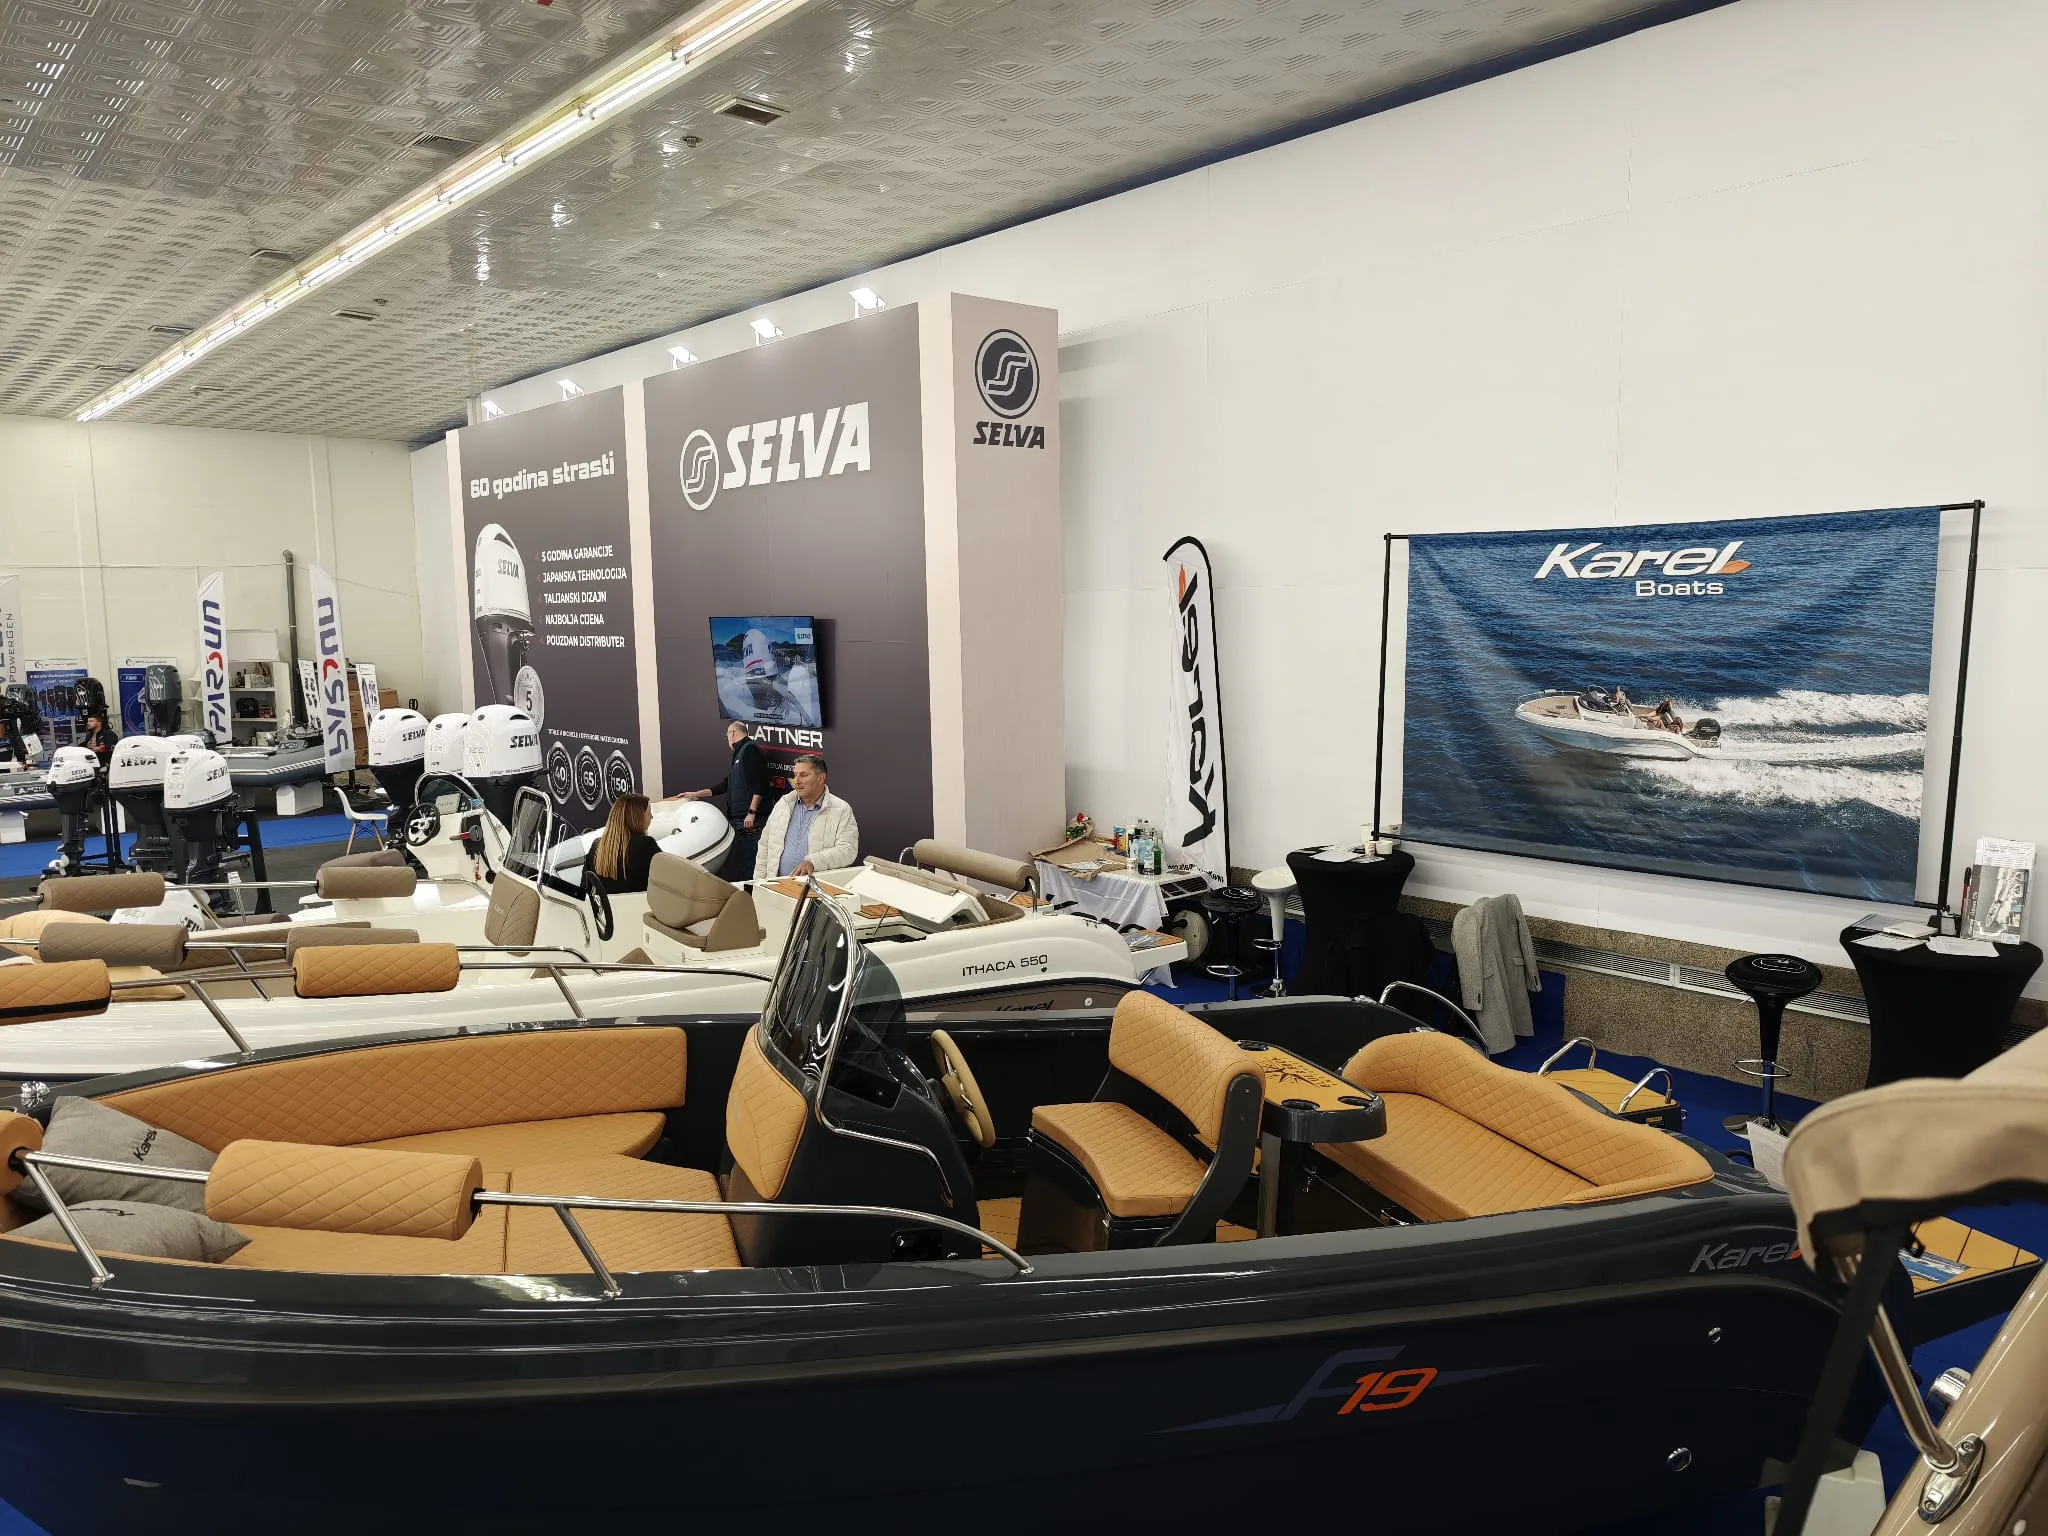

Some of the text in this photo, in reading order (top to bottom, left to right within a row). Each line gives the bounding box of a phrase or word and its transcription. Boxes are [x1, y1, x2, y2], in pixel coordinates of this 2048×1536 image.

[972, 420, 1045, 450] SELVA
[722, 401, 871, 490] SELVA
[470, 450, 615, 501] 60 godina strasti
[541, 545, 614, 562] 5 GODINA GARANCIJE
[1534, 541, 1750, 580] Karel
[542, 566, 628, 583] JAPANSKA TEHNOLOGIJA
[581, 591, 607, 603] DIZAJN
[1635, 580, 1724, 597] Boats
[545, 613, 605, 625] NAJBOLJA CIJENA
[6, 613, 17, 683] POWERGEN
[546, 634, 625, 648] POUZDAN DISTRIBUTER
[526, 690, 533, 711] 5
[402, 729, 426, 742] SELVA
[120, 755, 158, 768] SELVA
[555, 766, 566, 781] 40
[583, 771, 594, 787] 65
[962, 954, 1048, 977] ITHACA 550
